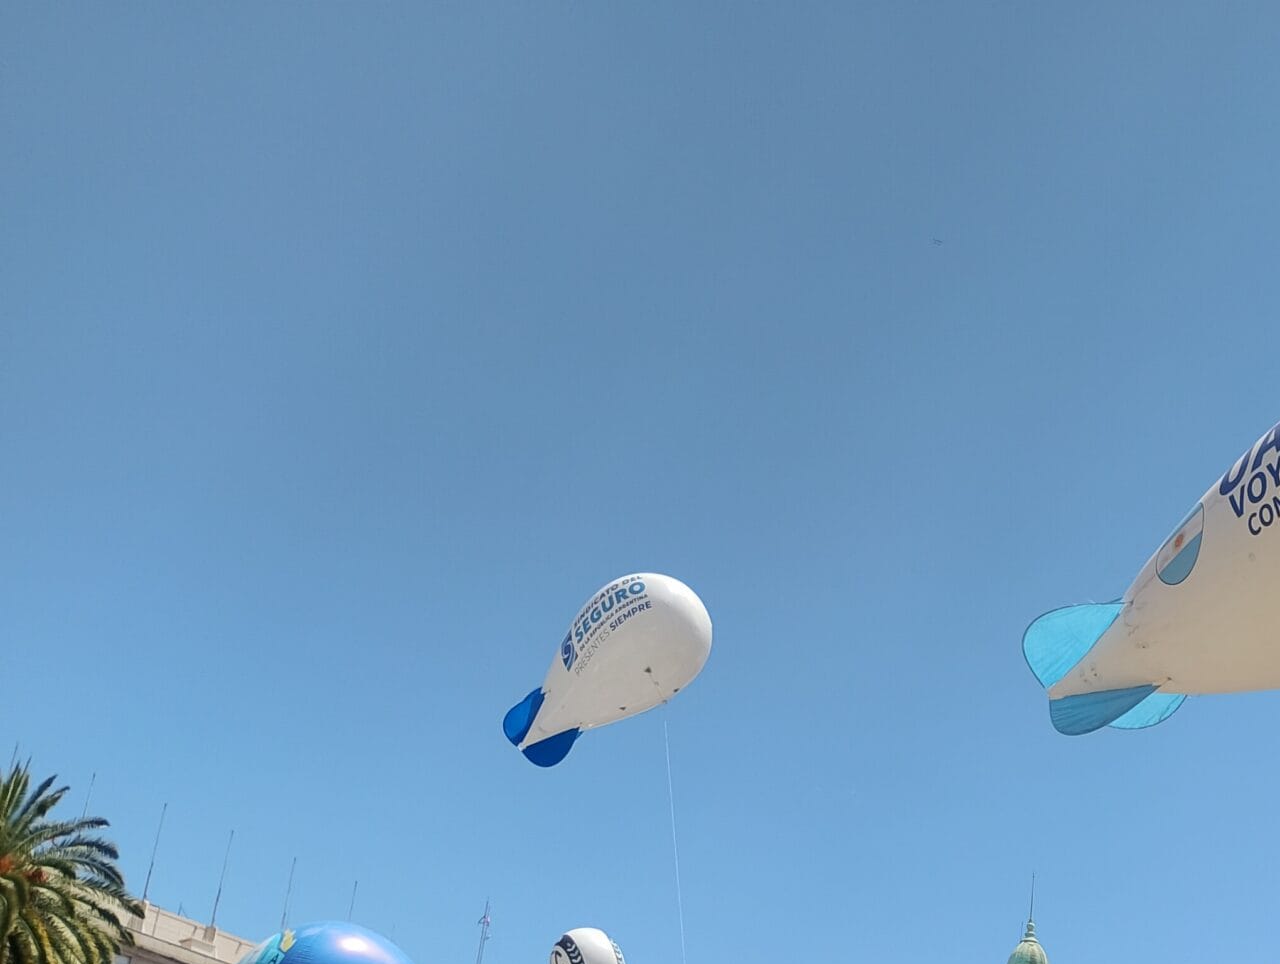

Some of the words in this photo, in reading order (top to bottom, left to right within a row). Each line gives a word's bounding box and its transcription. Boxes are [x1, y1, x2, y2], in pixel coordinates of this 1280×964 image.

[574, 628, 610, 676] PRESENTES
[609, 600, 652, 632] SIEMPRE
[575, 581, 646, 644] SEGURO
